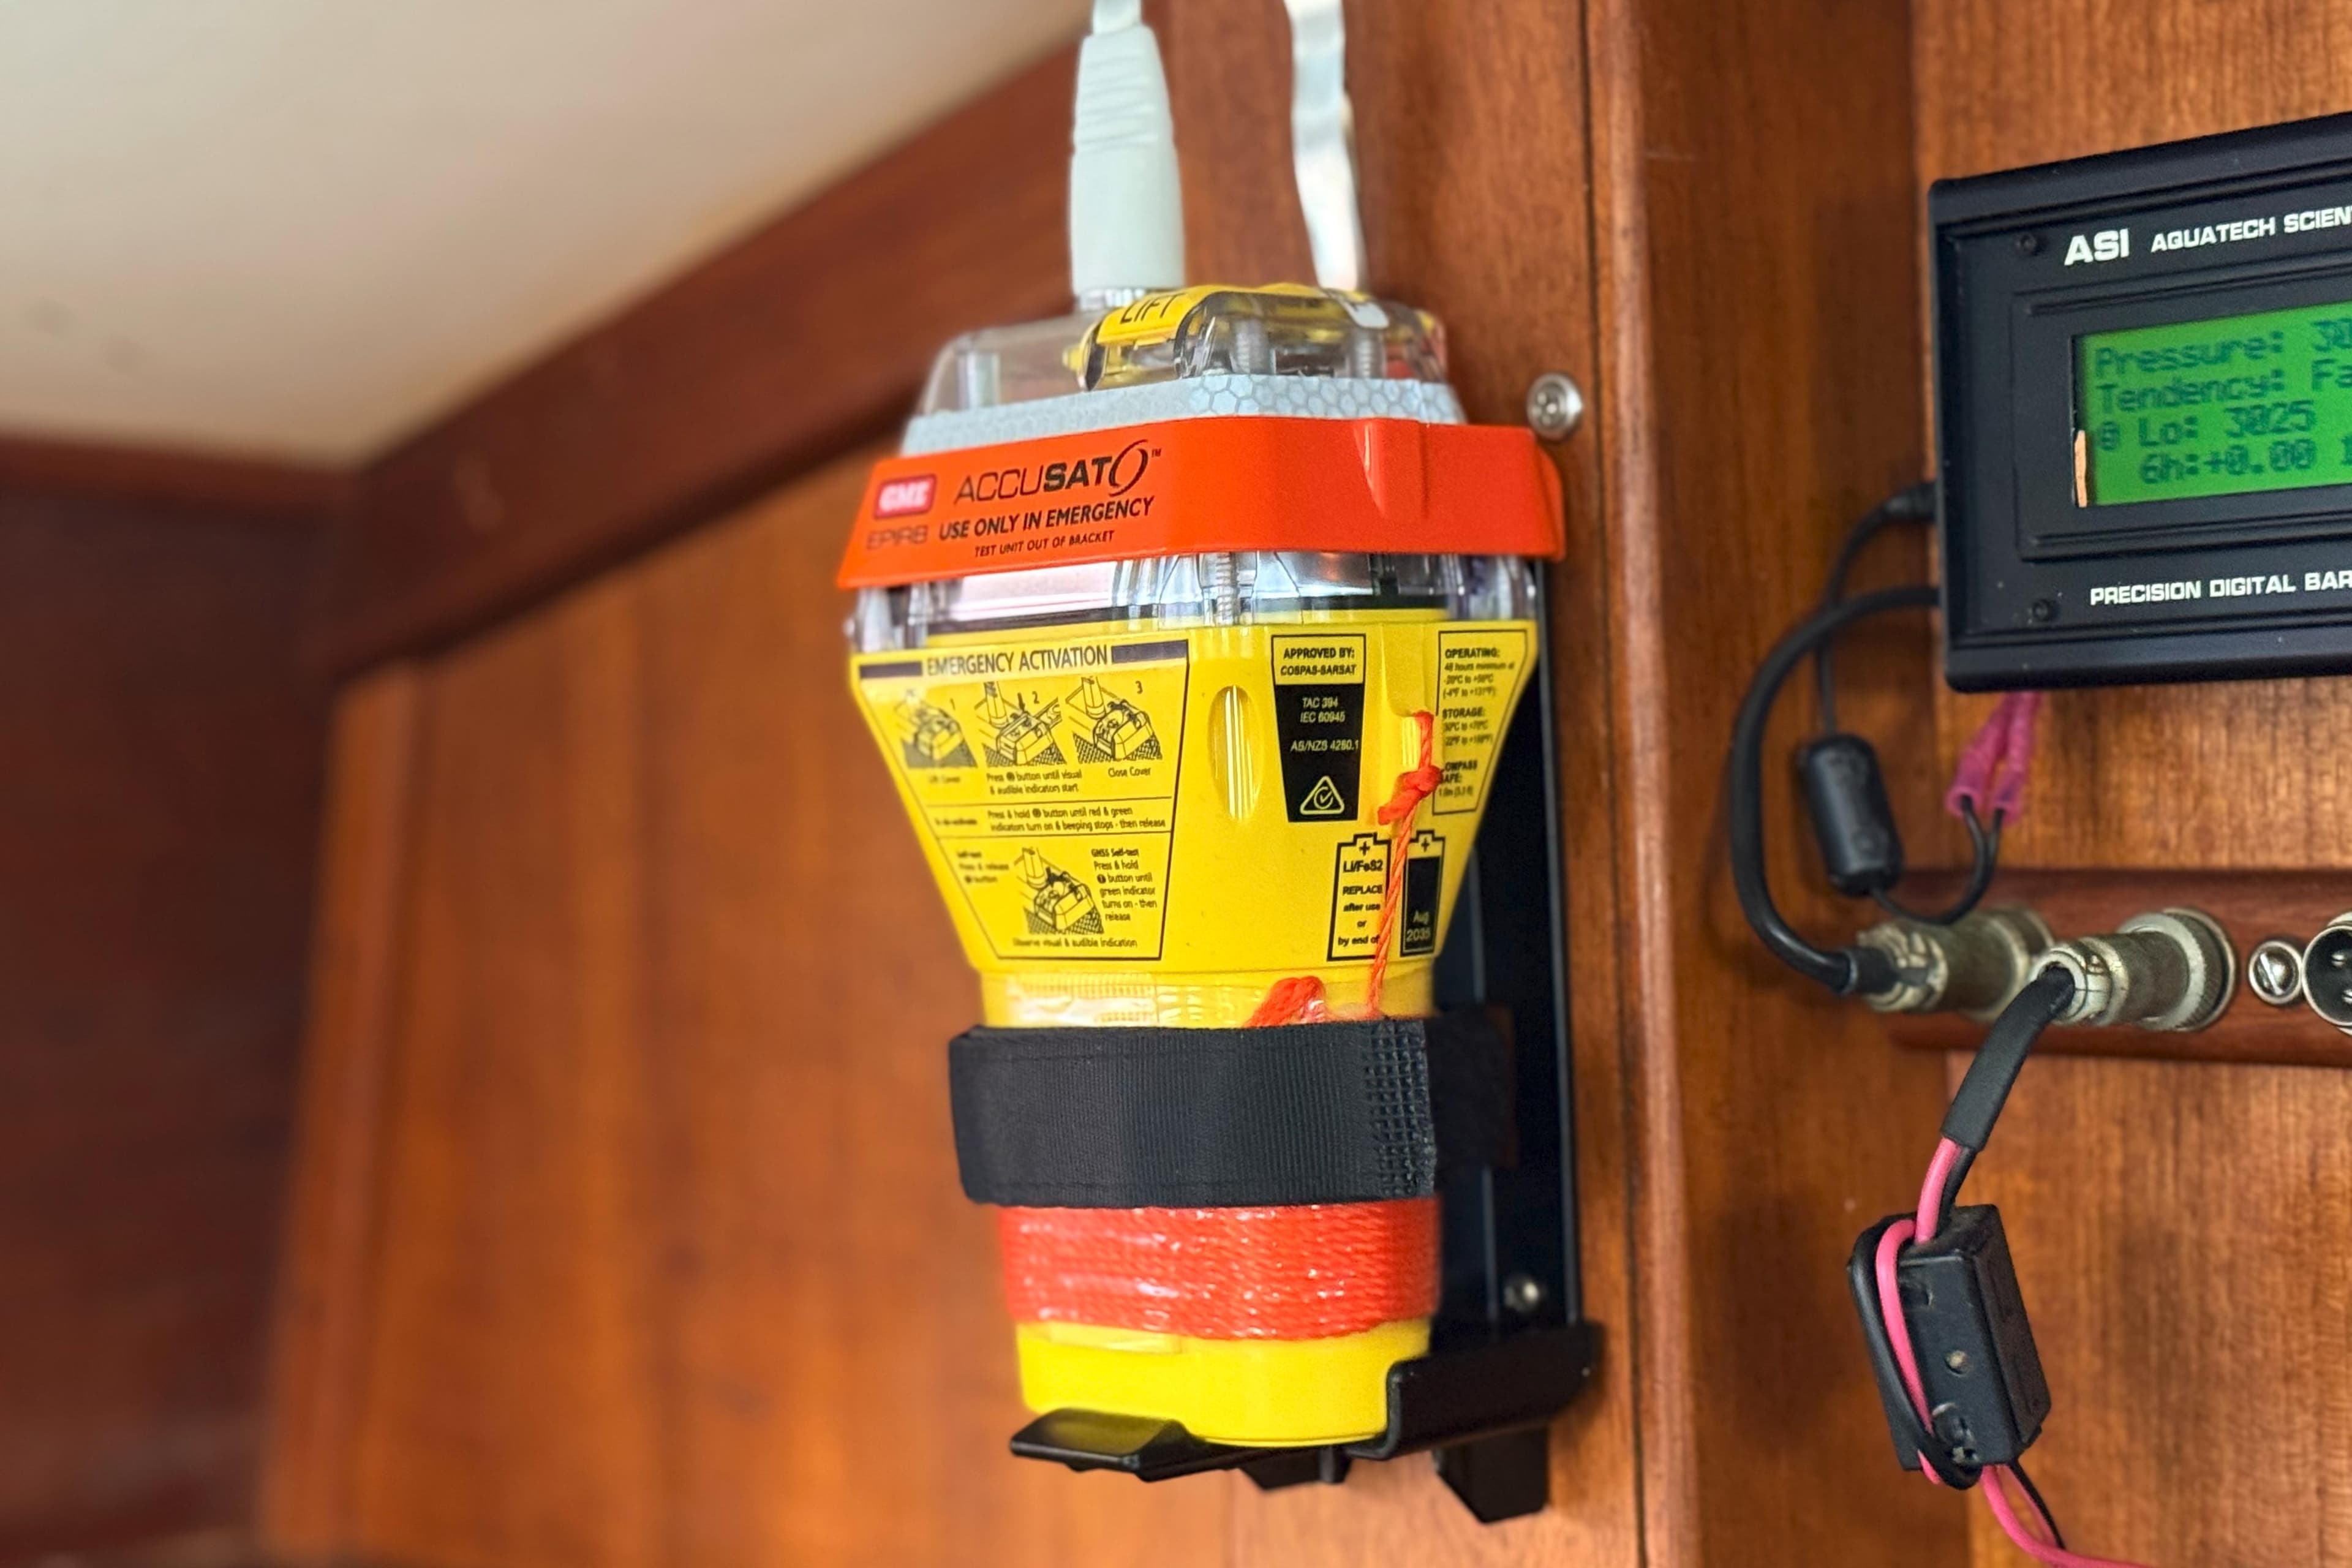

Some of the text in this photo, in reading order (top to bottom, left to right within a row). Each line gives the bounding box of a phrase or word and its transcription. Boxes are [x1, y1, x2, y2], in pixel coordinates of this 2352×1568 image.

[2064, 205, 2352, 265] ASI AQUATECH SCIEN
[1120, 292, 1188, 325] LIFT
[2095, 330, 2284, 377] Pressure:
[2096, 369, 2285, 414] Tendency:
[2138, 415, 2198, 448] Lo:
[940, 496, 1155, 540] USE ONLY IN EMERGENCY
[865, 524, 928, 550] EPIRB
[975, 530, 1115, 557] TEST UNIT OUT OF BRACKET
[2090, 570, 2352, 605] PRECISION DIGITAL BAR
[1284, 647, 1355, 659] APPROVED BY:
[1445, 647, 1500, 658] OPERATING:
[927, 644, 1107, 676] EMERGENCY ACTIVATION
[1280, 665, 1357, 676] COSPAS-SARSAT
[1135, 681, 1144, 695] 3
[1031, 691, 1040, 704] 2
[1302, 696, 1338, 709] TAC 394
[950, 698, 956, 710] 1
[1300, 712, 1316, 723] IEC
[1291, 740, 1328, 752] AS/NZS
[1108, 766, 1152, 778] Close Cover
[1441, 760, 1477, 772] OMPASS
[1089, 805, 1101, 816] red
[1107, 872, 1134, 883] button
[1135, 872, 1153, 882] until
[1343, 885, 1383, 895] REPLACE
[1139, 899, 1158, 908] then
[1343, 903, 1363, 911] after
[1338, 937, 1349, 947] by
[1352, 936, 1368, 944] end
